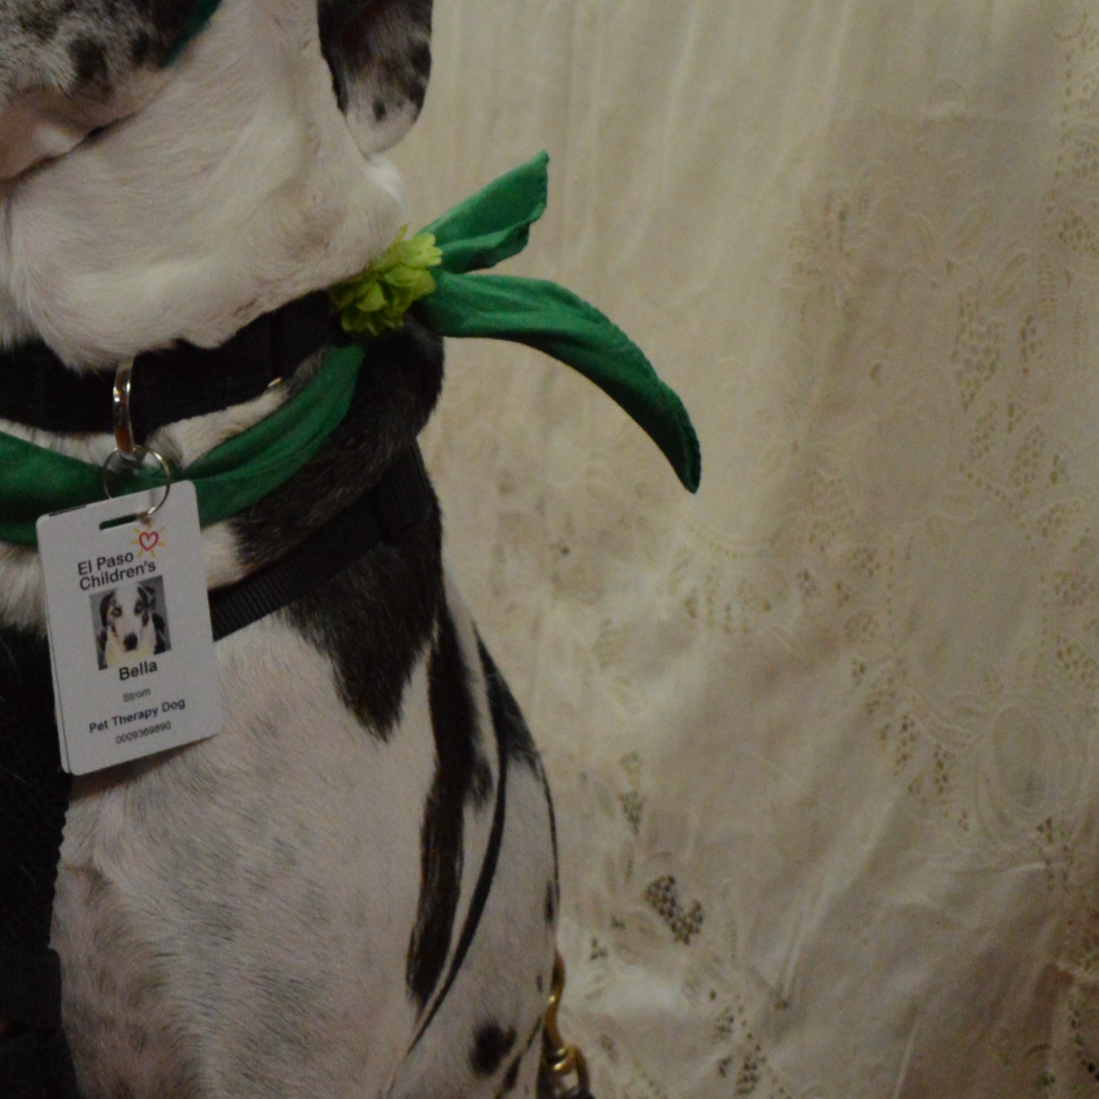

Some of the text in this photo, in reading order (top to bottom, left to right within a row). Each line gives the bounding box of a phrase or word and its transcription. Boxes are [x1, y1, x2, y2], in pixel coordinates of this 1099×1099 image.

[77, 551, 134, 576] El Paso
[79, 560, 157, 591] Children's
[118, 660, 158, 681] Bella
[122, 688, 151, 703] Strom
[89, 699, 186, 734] Pet Therapy Dog
